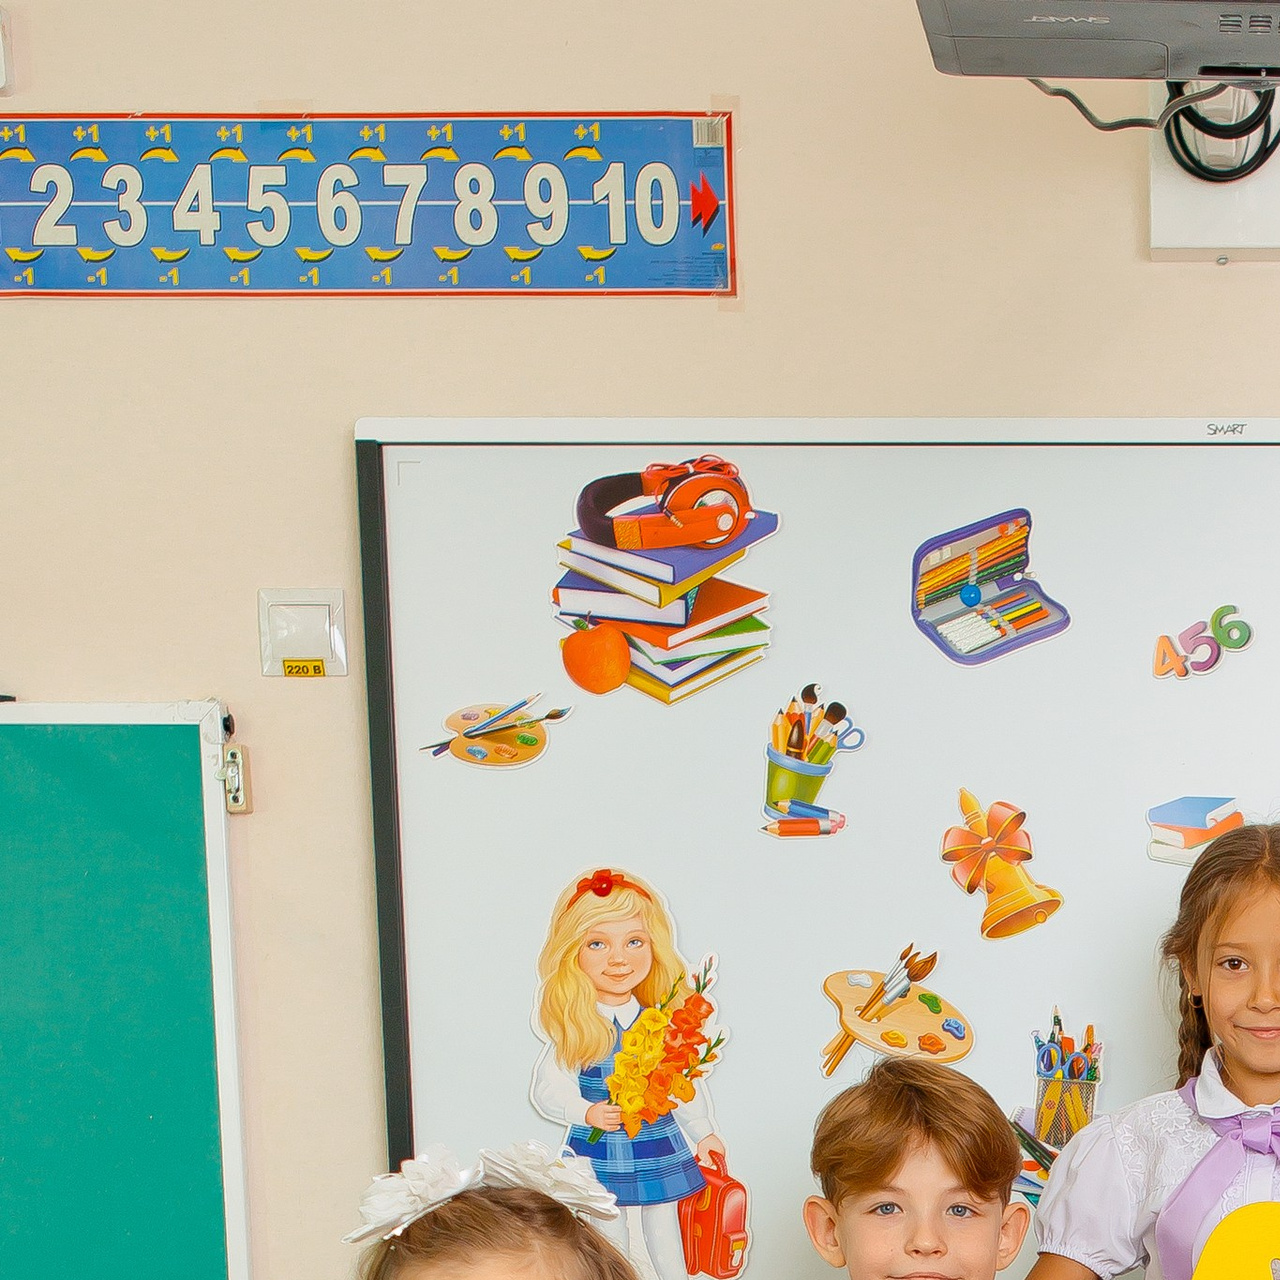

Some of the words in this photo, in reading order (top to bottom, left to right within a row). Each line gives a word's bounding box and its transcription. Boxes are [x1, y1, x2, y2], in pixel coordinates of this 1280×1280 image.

[0, 124, 26, 143] +1
[73, 124, 99, 143] +1
[145, 124, 172, 143] +1
[217, 124, 243, 143] +1
[286, 124, 313, 143] +1
[359, 124, 386, 143] +1
[426, 123, 453, 142] +1
[499, 122, 526, 141] +1
[574, 122, 600, 141] +1
[29, 163, 78, 246] 2
[101, 163, 148, 247] 3
[172, 163, 221, 246] 4
[245, 163, 292, 247] 5
[316, 162, 363, 247] 6
[382, 163, 428, 246] 7
[453, 162, 499, 247] 8
[523, 161, 570, 246] 9
[592, 160, 680, 246] 10
[14, 267, 35, 285] -1
[86, 267, 108, 285] -1
[159, 267, 180, 285] -1
[230, 267, 250, 285] -1
[299, 267, 320, 285] -1
[372, 267, 392, 285] -1
[438, 266, 459, 285] -1
[510, 266, 531, 285] -1
[585, 266, 606, 285] -1
[1206, 423, 1248, 435] SMART
[1153, 604, 1253, 678] 456
[286, 665, 309, 675] 220
